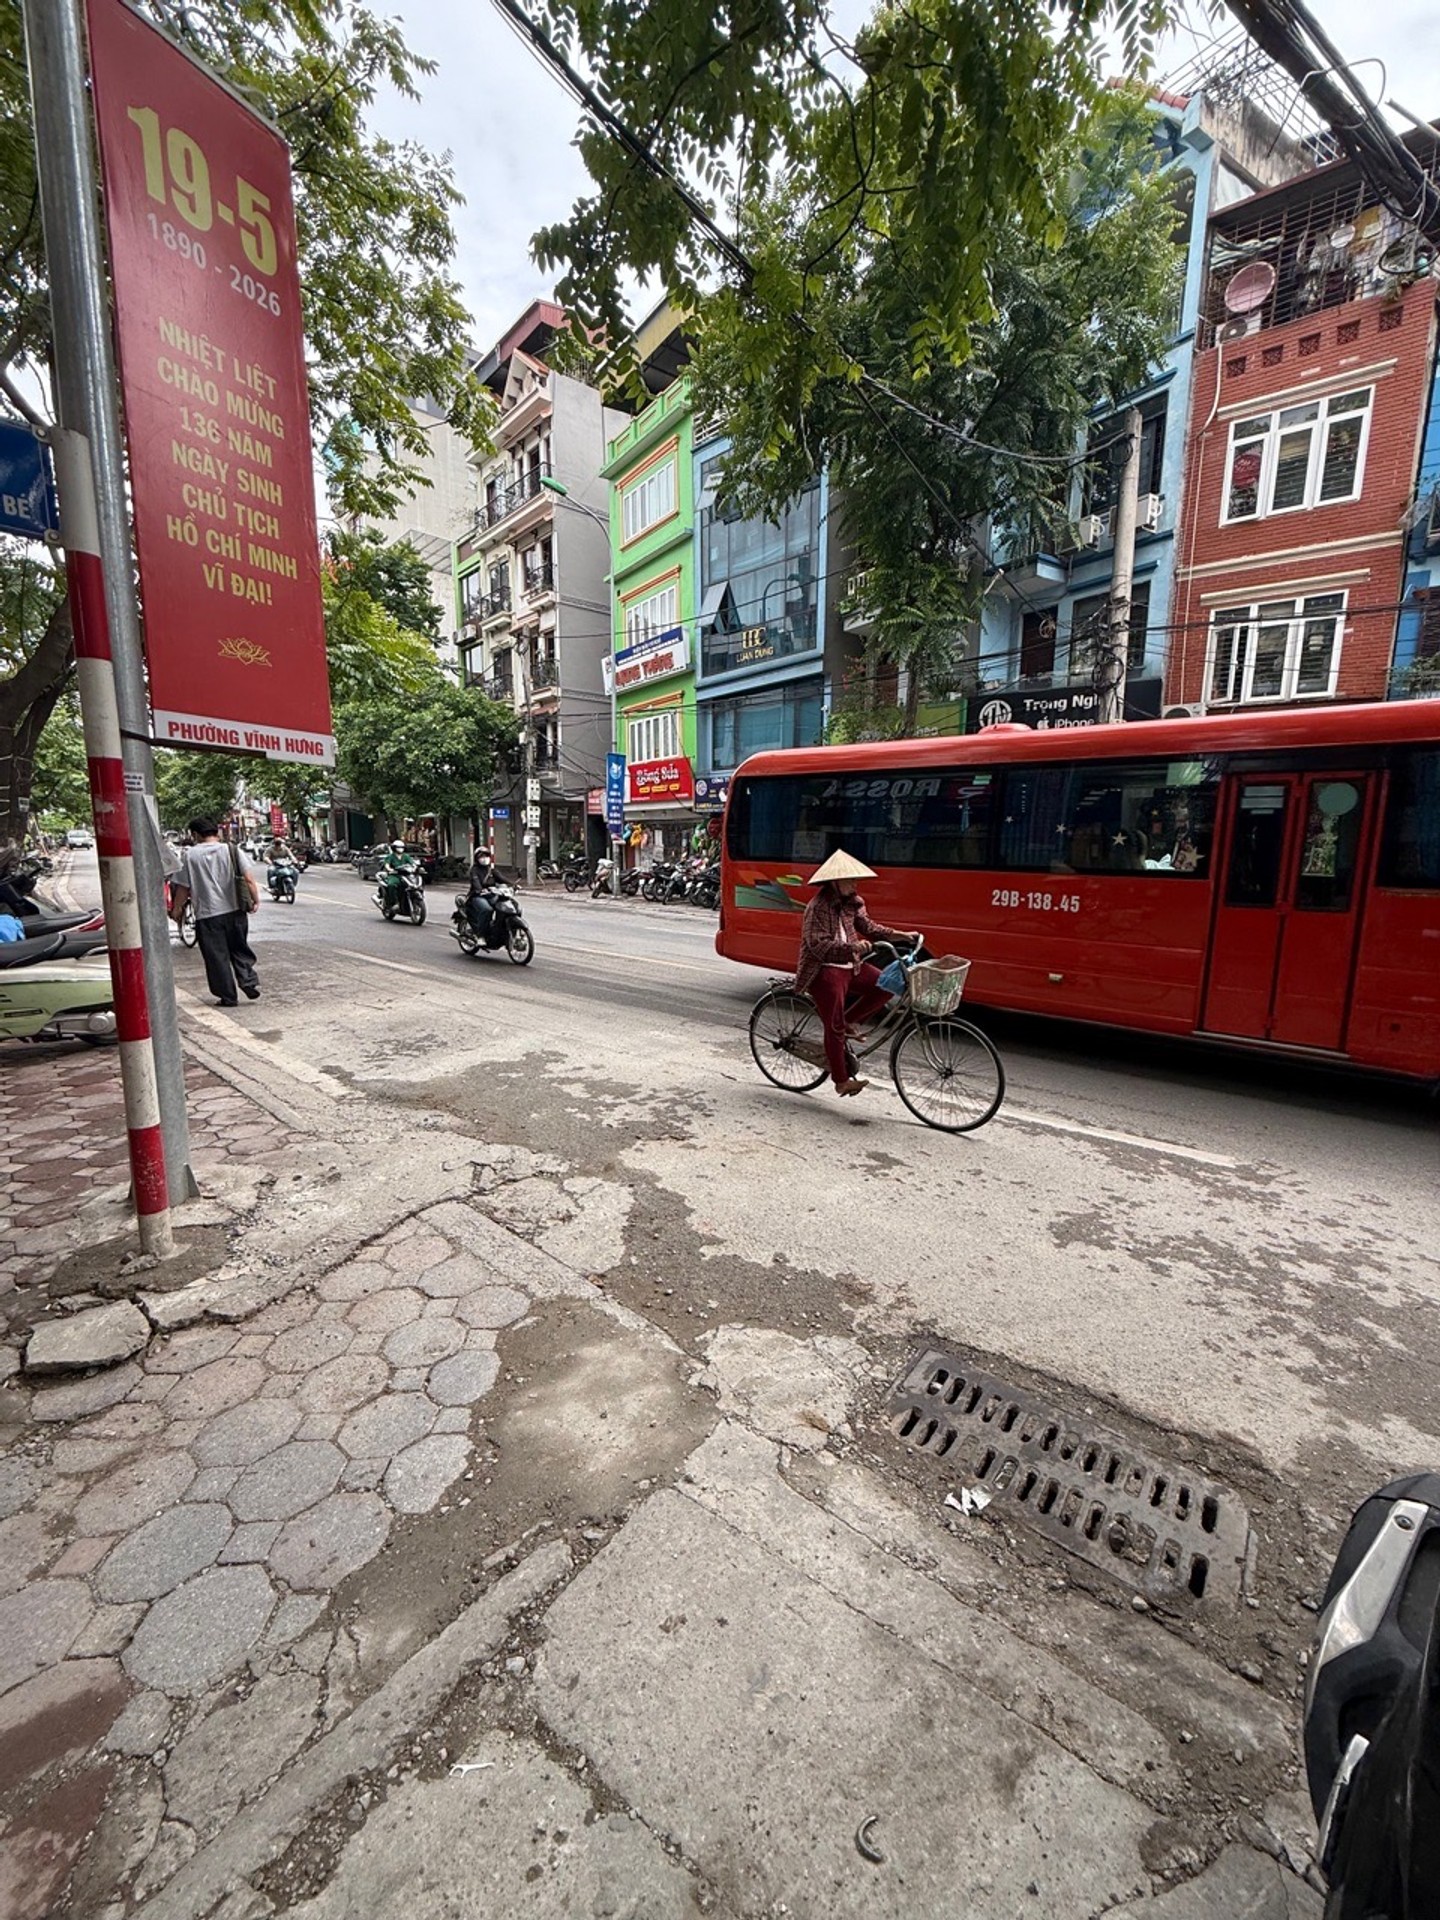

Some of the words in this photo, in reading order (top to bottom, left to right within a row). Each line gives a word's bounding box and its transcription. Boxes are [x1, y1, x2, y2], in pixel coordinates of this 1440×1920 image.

[127, 105, 278, 276] 19-5
[147, 212, 207, 270] 1890
[229, 264, 282, 317] 2026
[158, 316, 226, 373] NHIỆT
[233, 357, 277, 400] LIỆT
[156, 356, 219, 407] CHÀO
[226, 390, 285, 440] MỪNG
[179, 406, 222, 444] 136
[228, 426, 273, 468] NĂM
[172, 439, 230, 484] NGÀY
[237, 467, 283, 508] SINH
[182, 483, 227, 521] CHỦ
[232, 501, 280, 540] TỊCH
[166, 511, 200, 547] HỒ
[205, 529, 243, 562] CHÍ
[248, 542, 298, 580] MINH
[202, 562, 225, 592] VĨ
[231, 571, 273, 606] ĐẠI!
[168, 721, 240, 747] PHƯỜNG
[244, 730, 281, 751] VĨNH
[285, 737, 325, 757] HƯNG
[1023, 699, 1068, 714] Trọng
[991, 889, 1081, 913] 29B-138.45
